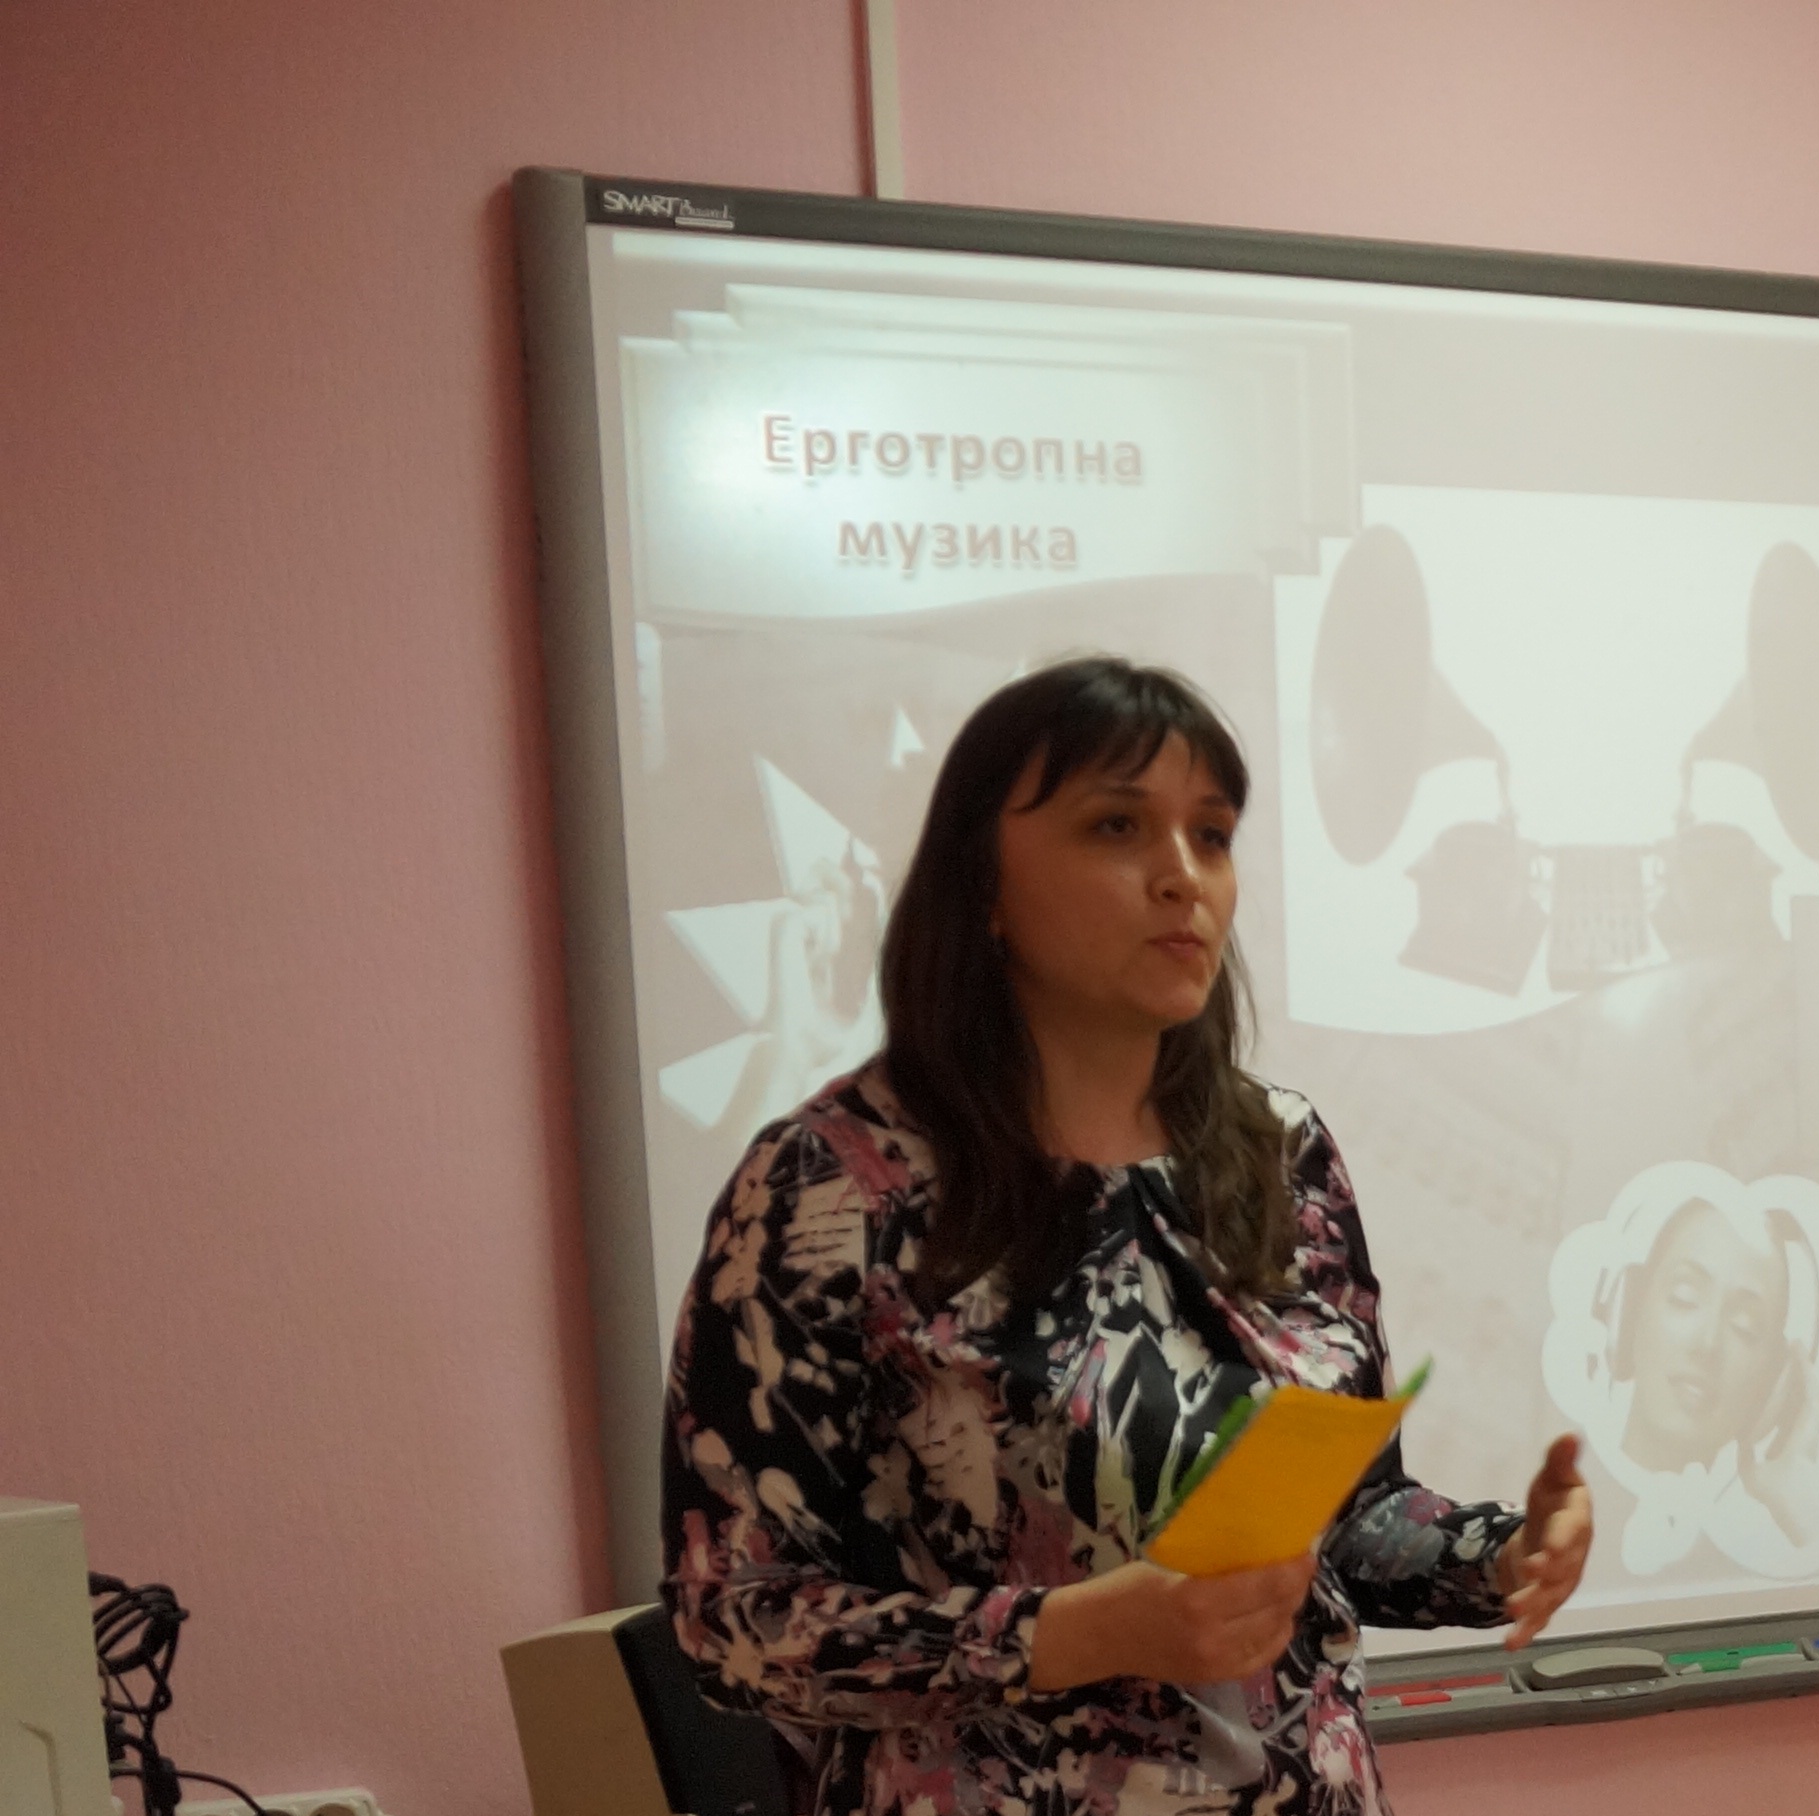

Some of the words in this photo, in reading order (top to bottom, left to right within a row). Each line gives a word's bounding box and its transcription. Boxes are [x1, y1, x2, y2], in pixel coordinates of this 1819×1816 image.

[603, 190, 681, 217] SMART
[762, 413, 1143, 484] Ерготропна
[838, 520, 1079, 572] музика
